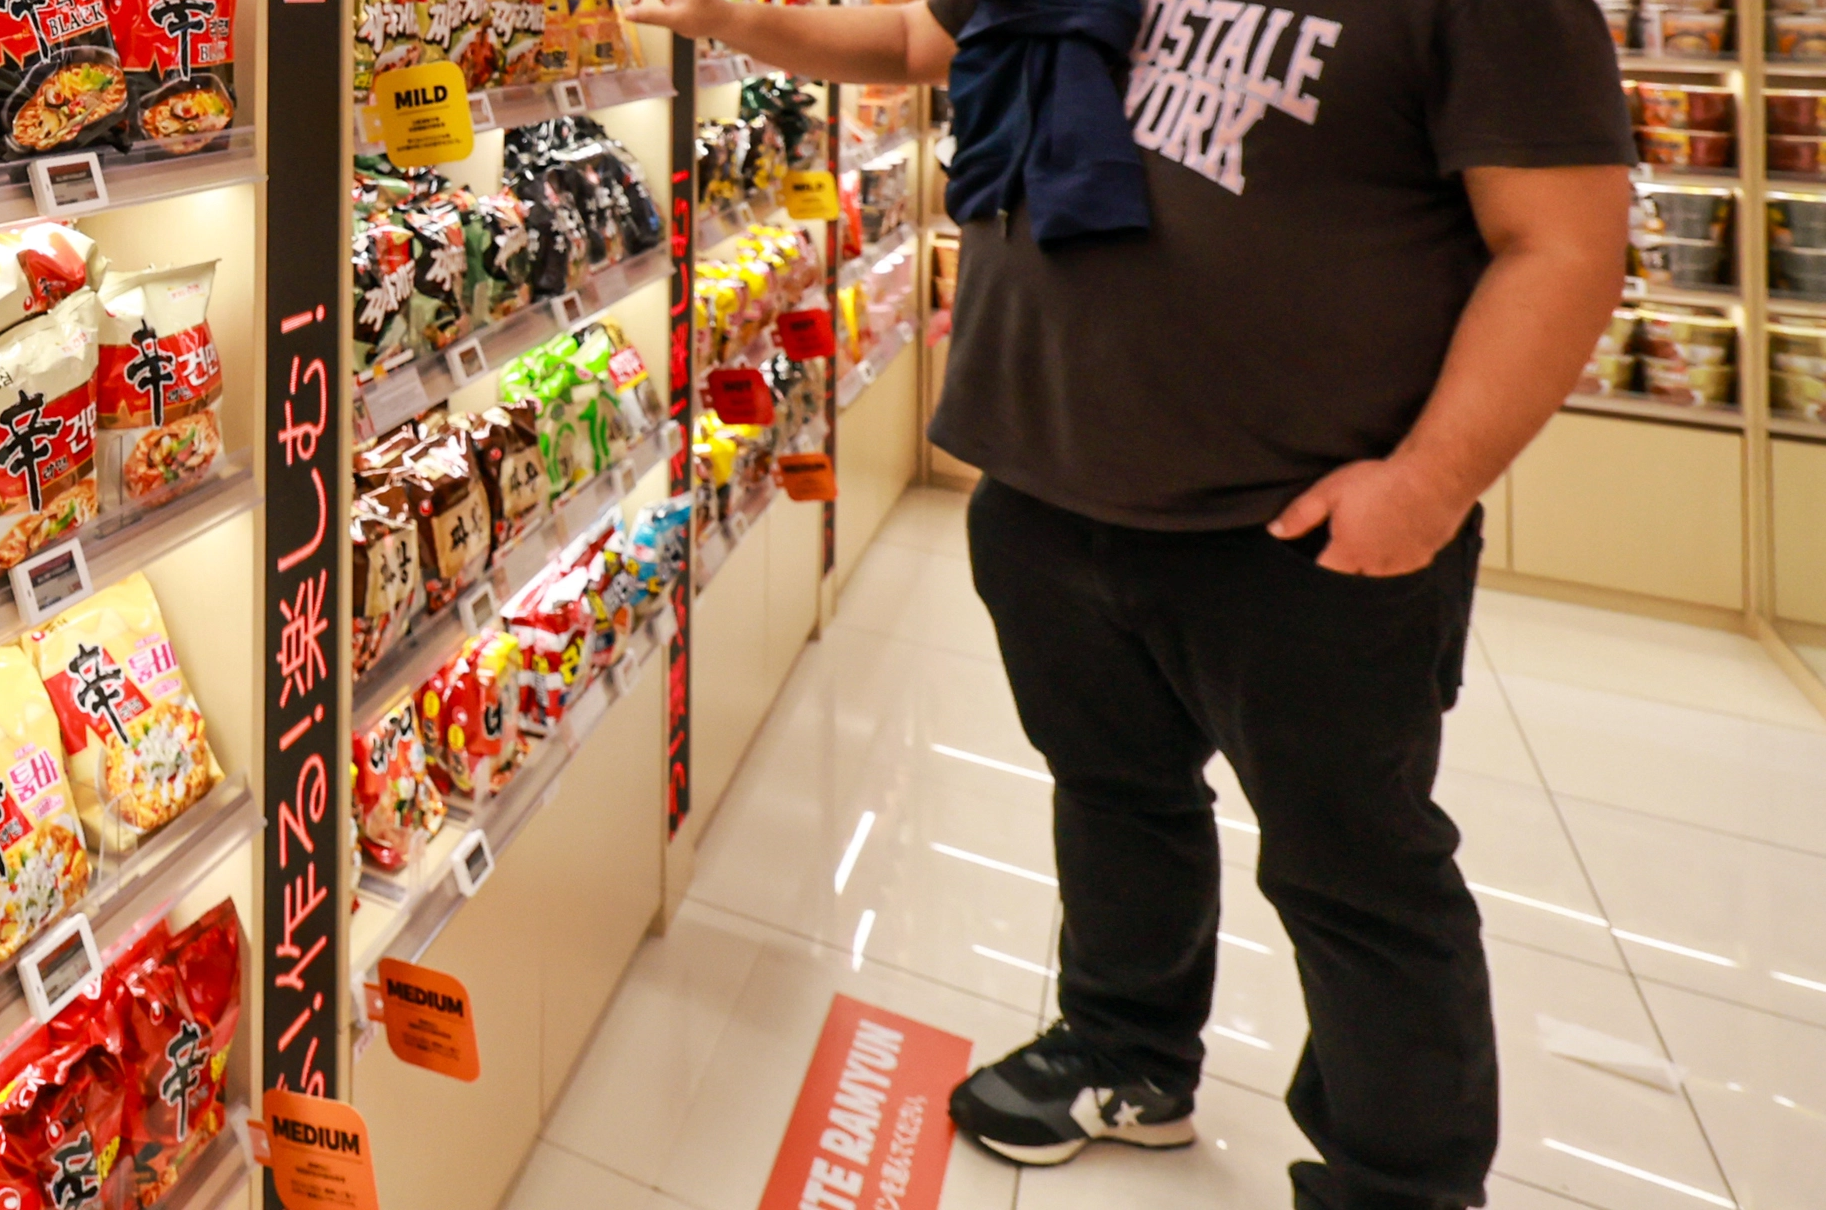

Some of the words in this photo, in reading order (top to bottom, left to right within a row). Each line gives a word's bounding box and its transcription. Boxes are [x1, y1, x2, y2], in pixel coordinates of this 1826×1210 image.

[48, 2, 107, 38] BLACK
[393, 84, 449, 111] MILD
[126, 318, 177, 429] 辛
[66, 641, 129, 746] 辛
[385, 977, 466, 1019] MEDIUM
[819, 1017, 906, 1167] RAMYUN
[271, 1113, 361, 1157] MEDIUM
